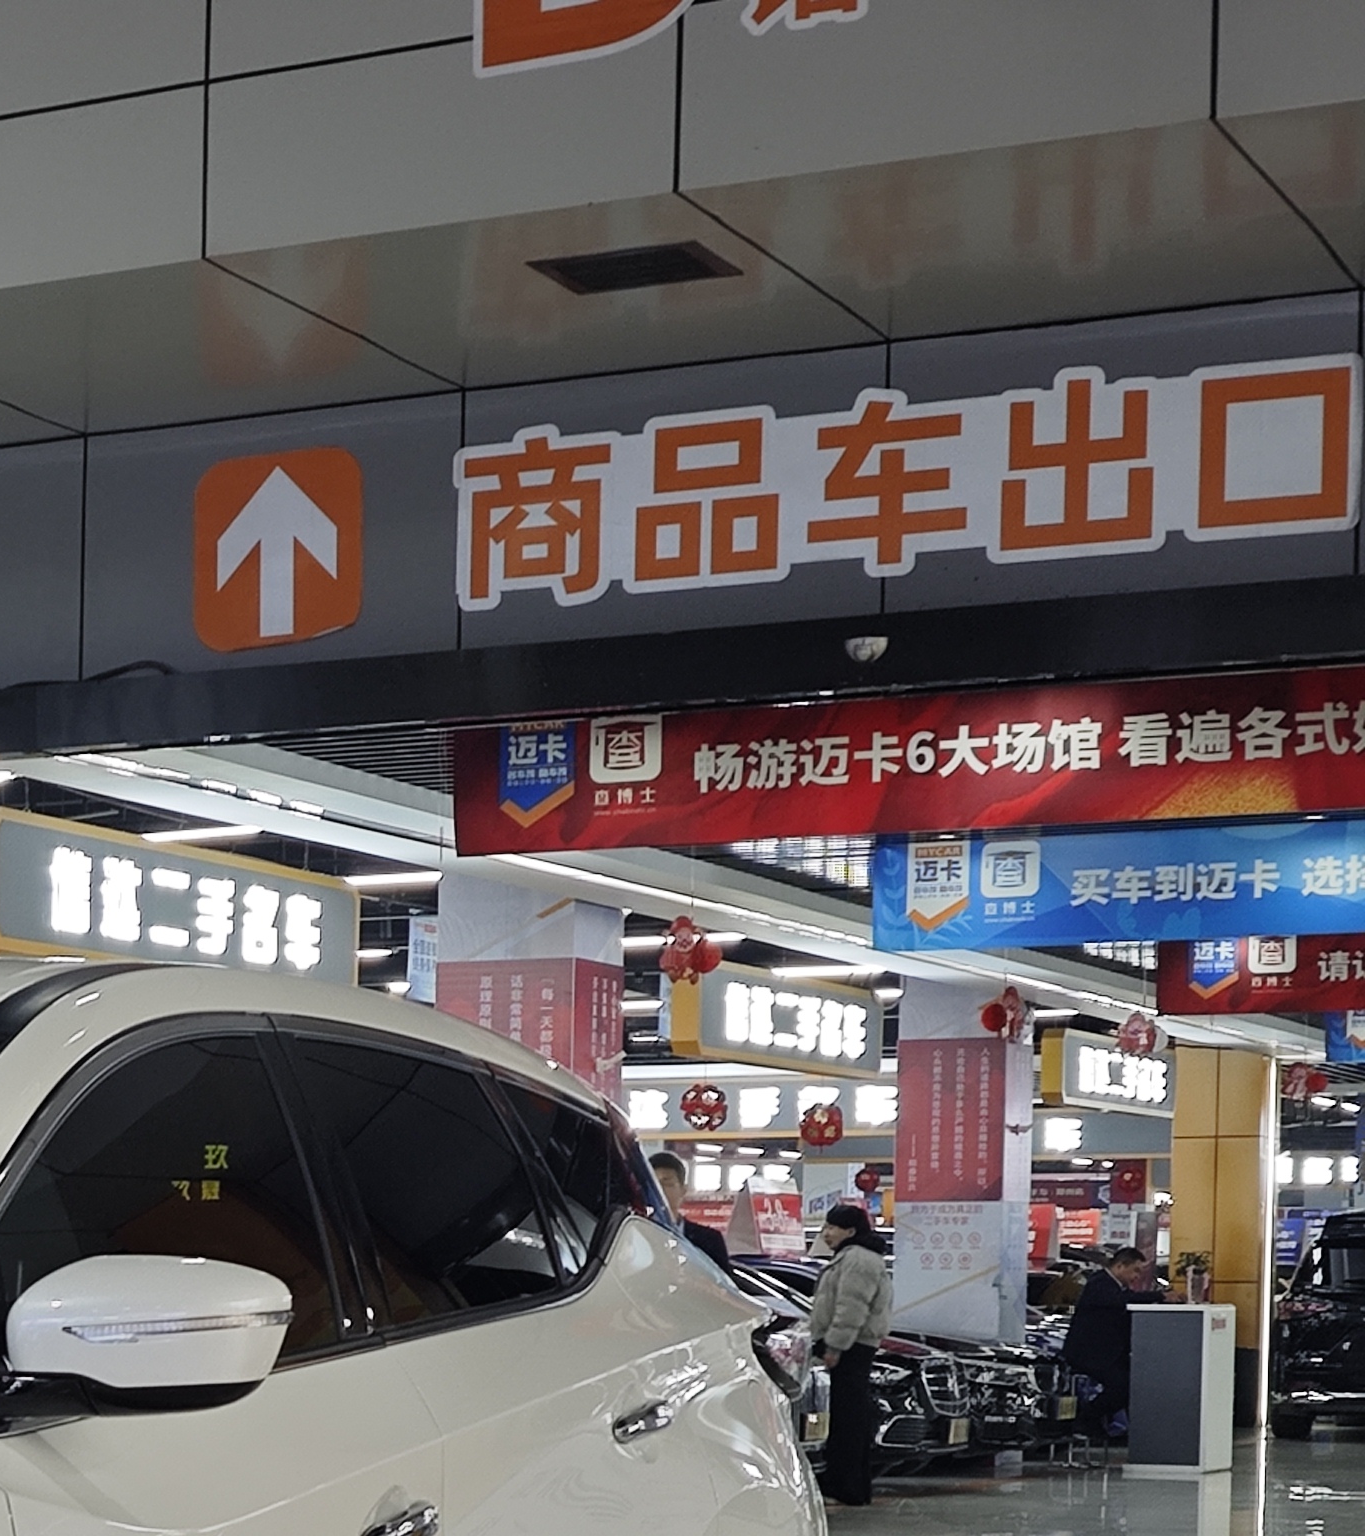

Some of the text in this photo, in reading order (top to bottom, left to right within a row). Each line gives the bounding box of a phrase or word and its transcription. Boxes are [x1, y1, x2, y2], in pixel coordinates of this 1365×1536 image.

[459, 364, 1359, 604] 商品车出口
[508, 733, 567, 766] 迈卡
[693, 716, 1103, 796] 畅游迈卡6大场馆
[594, 787, 657, 806] 查博士
[915, 859, 962, 883] 迈卡
[1070, 858, 1281, 907] 买车到迈卡
[984, 900, 1036, 915] 查博士
[1194, 941, 1234, 960] 迈卡
